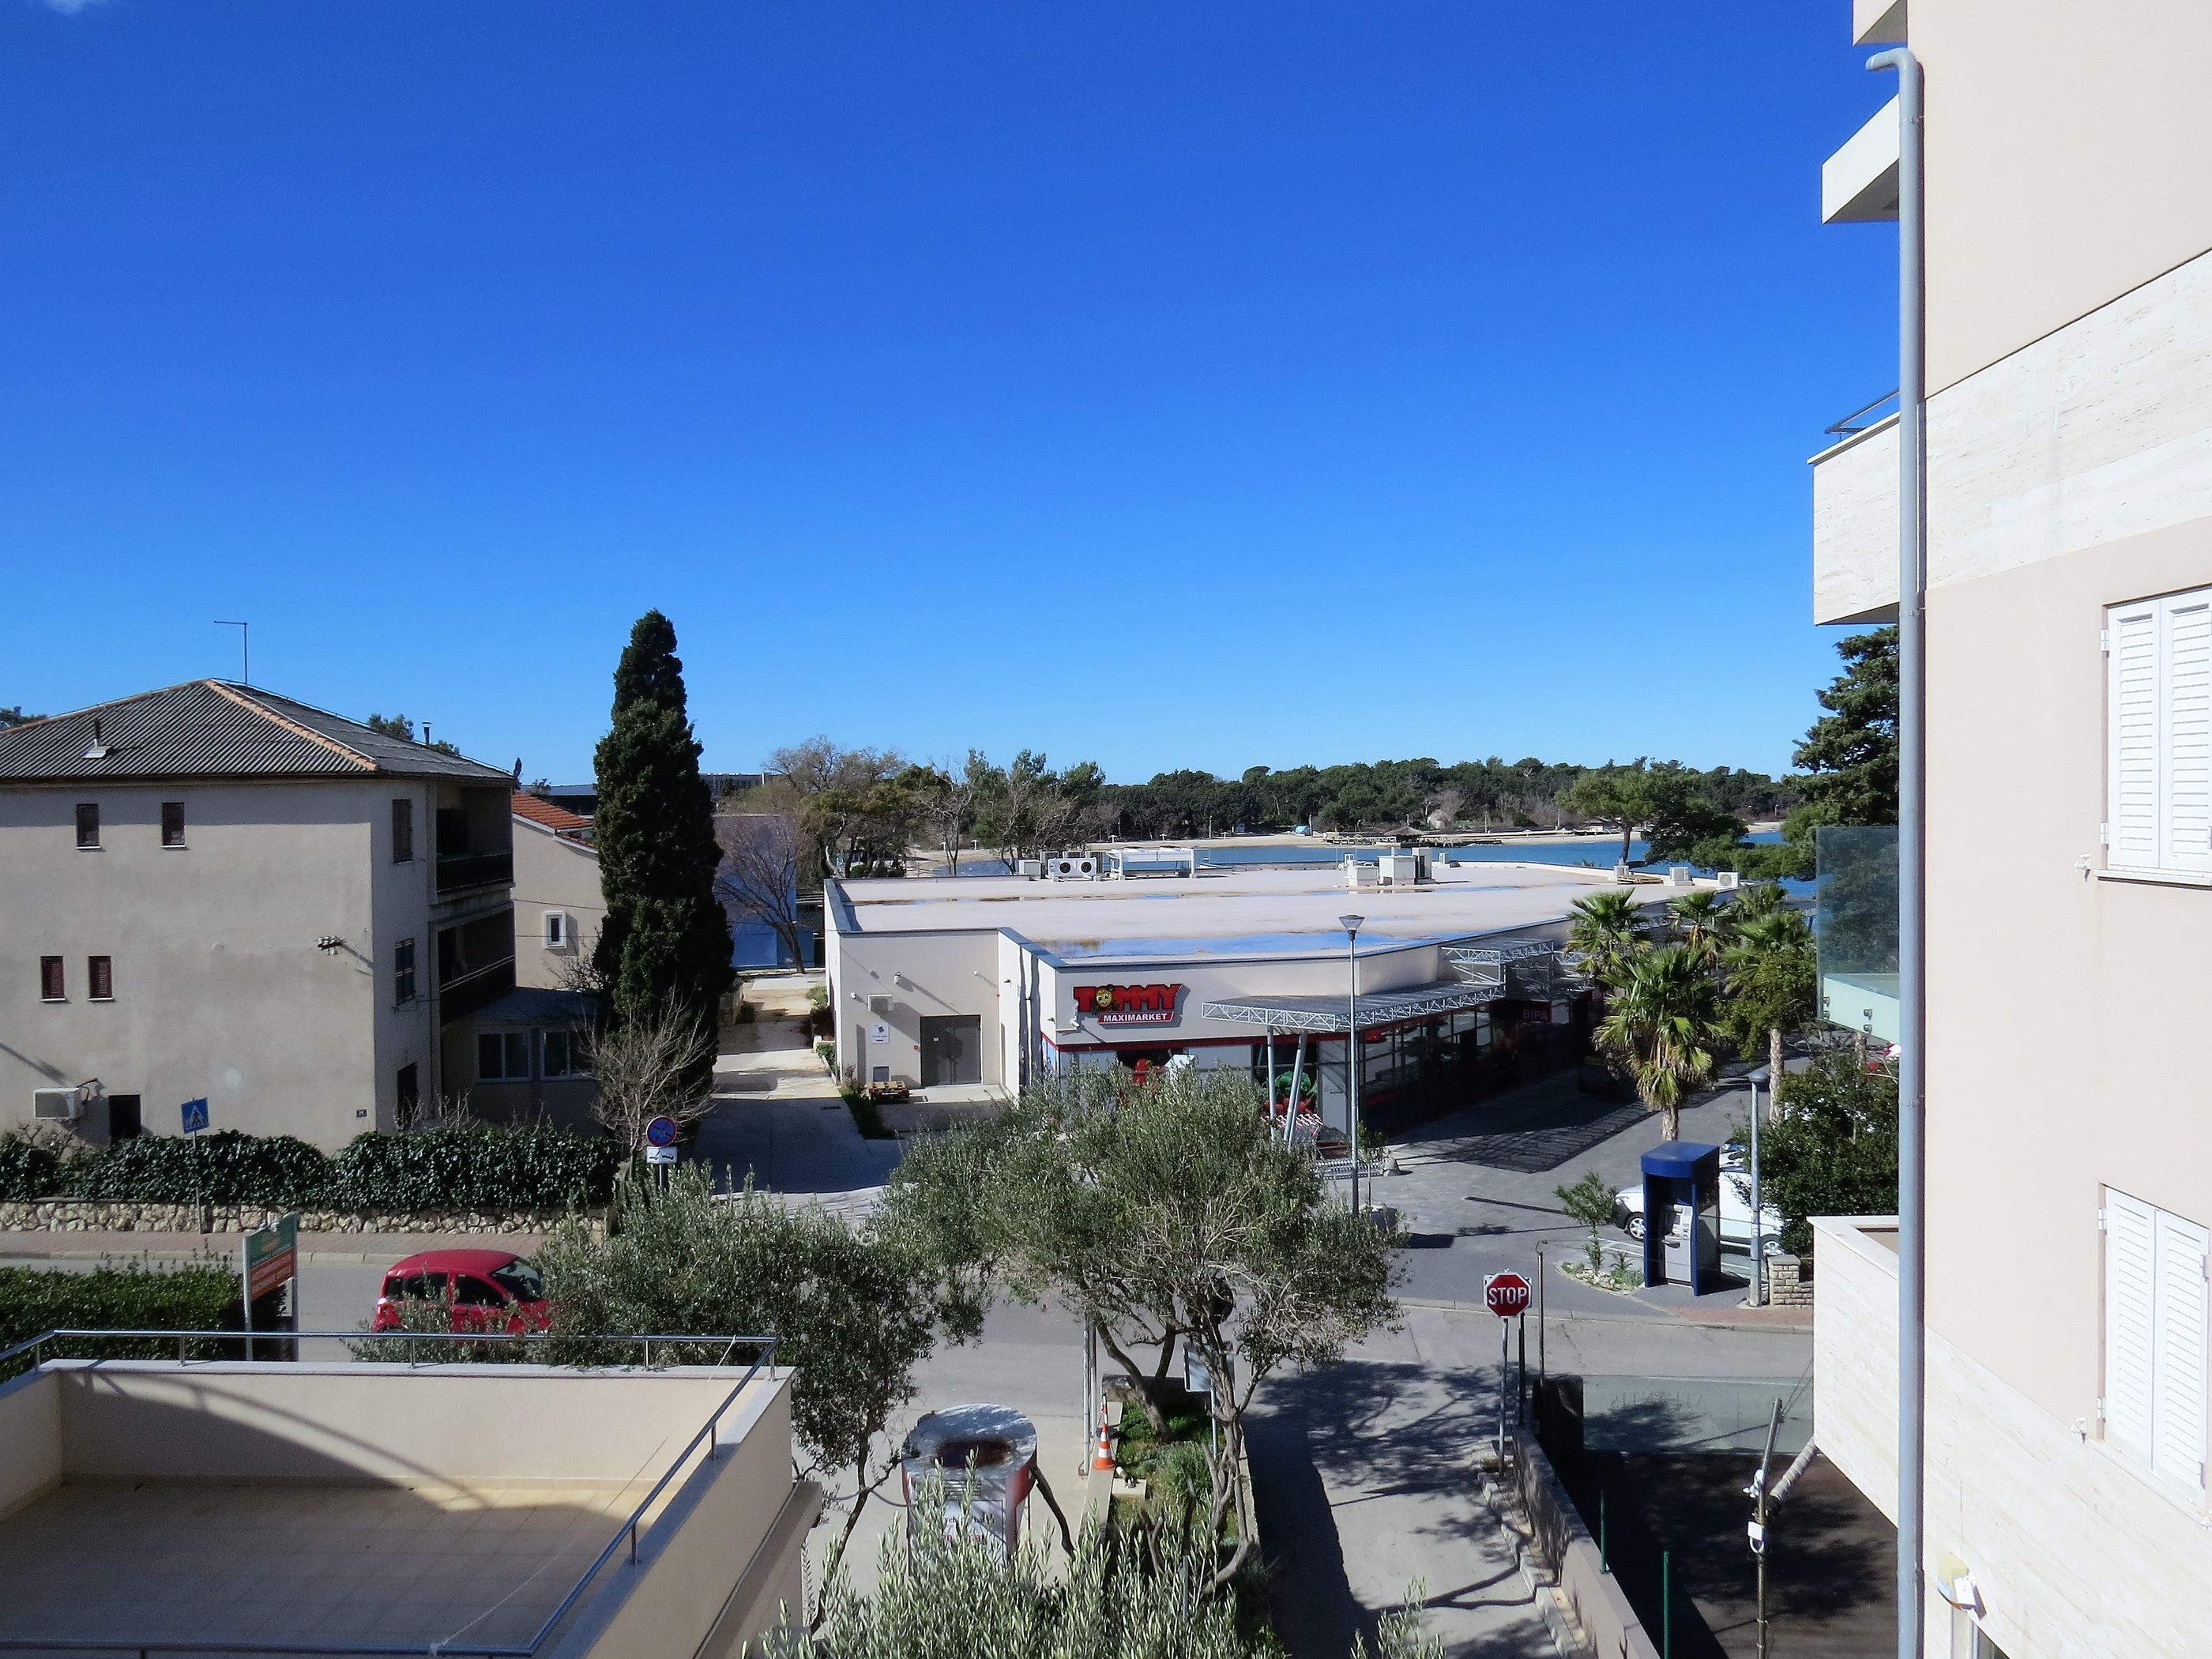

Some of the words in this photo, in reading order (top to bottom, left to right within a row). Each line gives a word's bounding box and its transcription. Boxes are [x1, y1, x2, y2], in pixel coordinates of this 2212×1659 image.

[1074, 984, 1182, 1012] TOMMY
[1104, 1013, 1168, 1023] MAXIMARKET
[1522, 1009, 1548, 1020] BIPA
[1488, 1287, 1527, 1305] STOP
